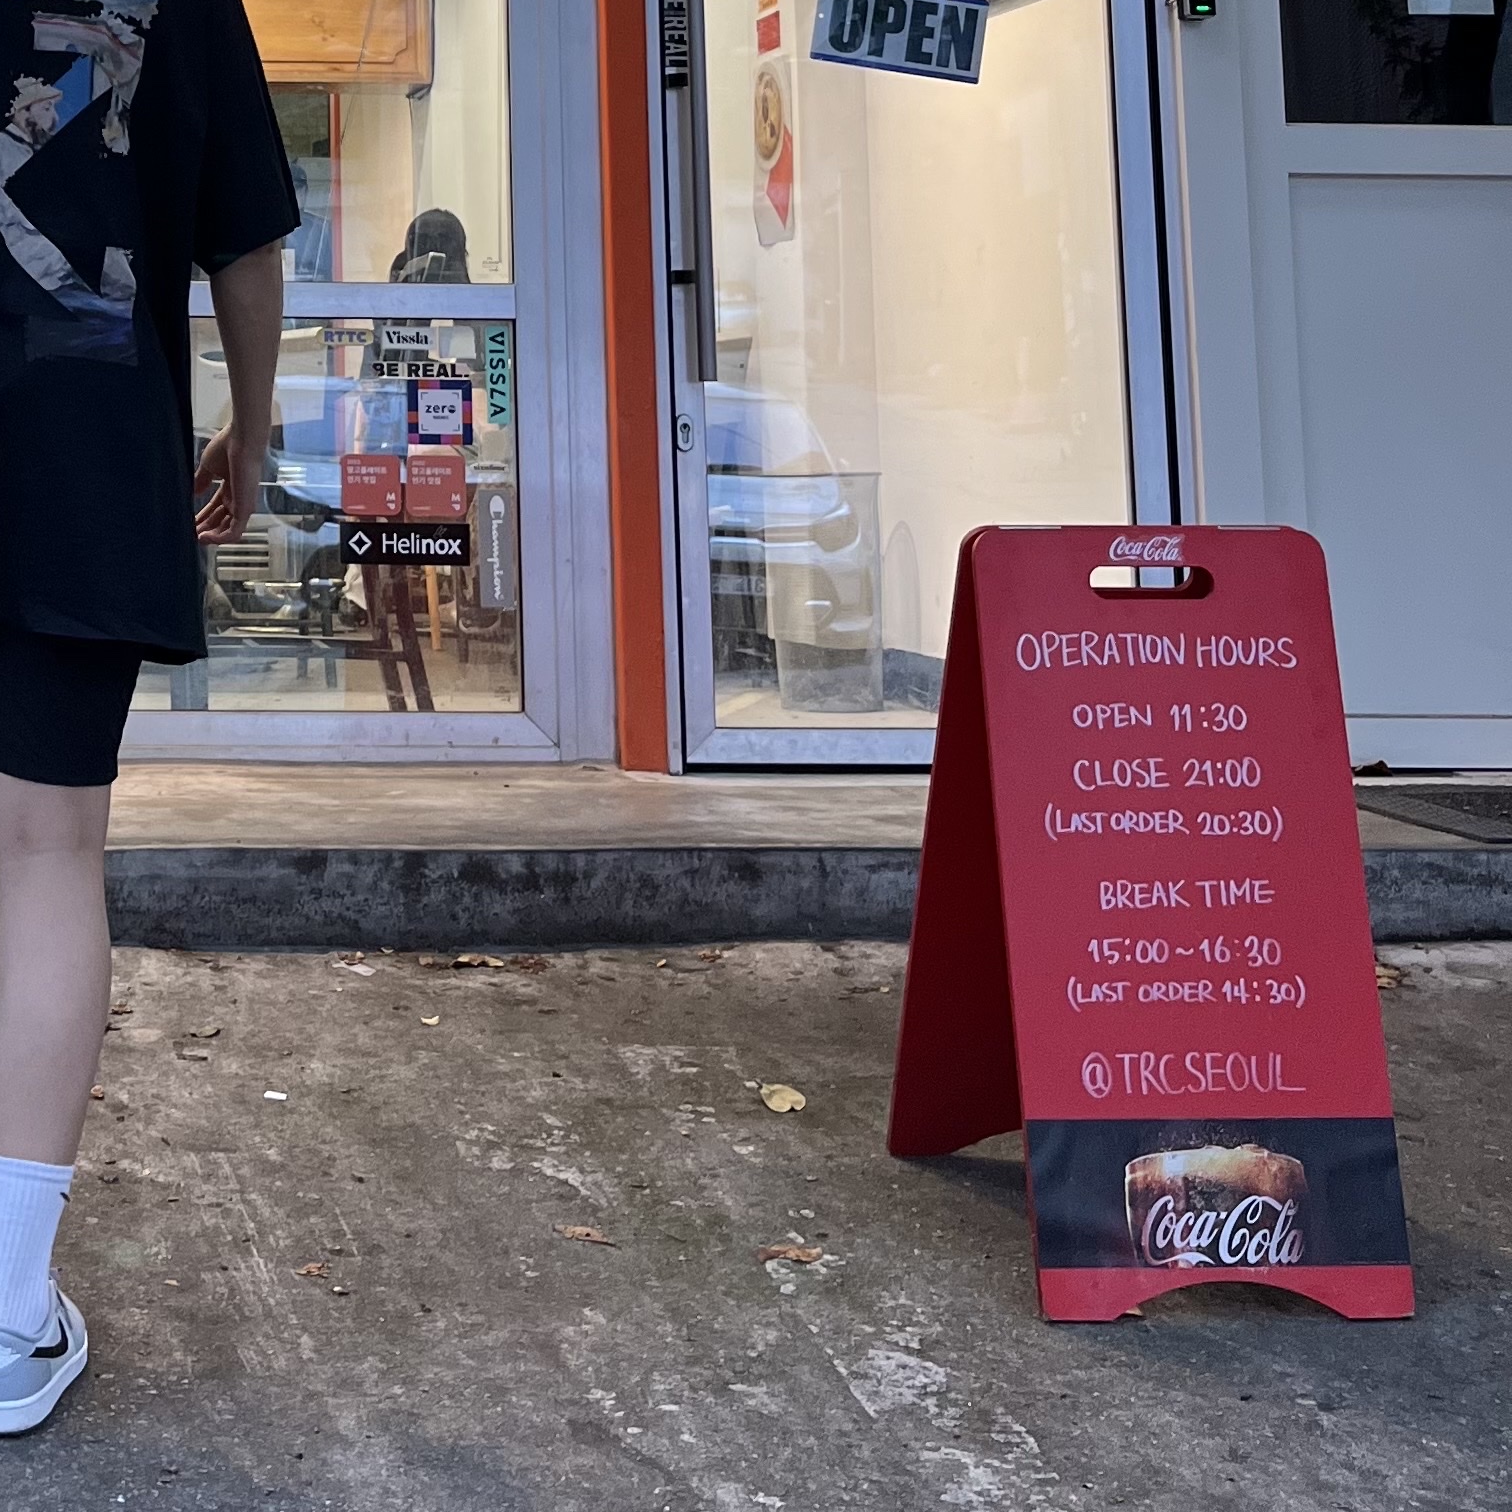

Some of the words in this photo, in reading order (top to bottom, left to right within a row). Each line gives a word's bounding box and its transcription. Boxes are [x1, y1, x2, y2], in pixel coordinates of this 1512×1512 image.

[323, 330, 367, 343] RTTC
[372, 363, 400, 377] BE
[407, 363, 470, 378] REAL.
[488, 331, 507, 418] VISSLA
[425, 405, 456, 414] zero
[382, 532, 462, 555] Helinox
[1108, 535, 1184, 562] Coca-Cola
[1015, 631, 1186, 671] OPERATION
[1196, 635, 1298, 669] HOURS
[1072, 703, 1153, 728] OPEN
[1170, 703, 1248, 733] 11:30
[1072, 757, 1170, 790] CLOSE
[1182, 756, 1262, 788] 21:00
[1044, 802, 1109, 842] (LAST
[1109, 808, 1190, 836] ORDER
[1196, 806, 1285, 843] 20:30)
[1099, 879, 1191, 910] BREAK
[1195, 877, 1276, 908] TIME
[1066, 975, 1131, 1013] (LAST
[1137, 979, 1219, 1003] ORDER
[1221, 974, 1307, 1009] 14:30)
[1081, 1050, 1307, 1100] @TRCSEOUL
[1142, 1193, 1306, 1267] Coca-Cola
